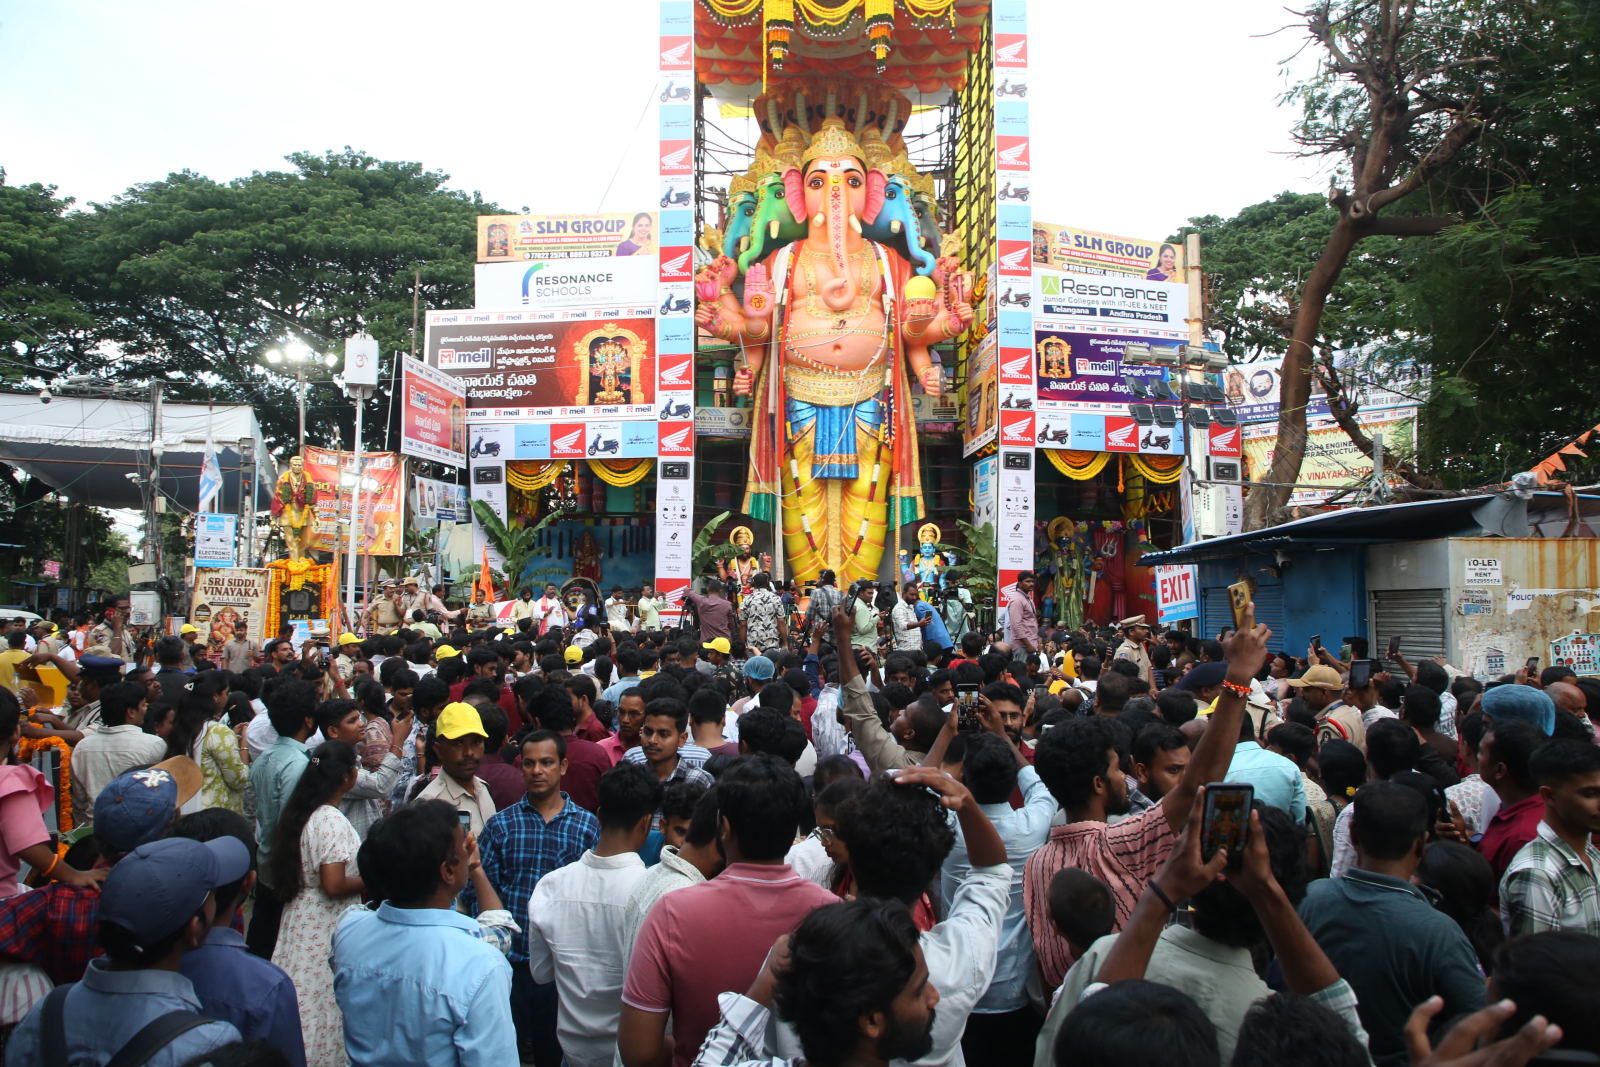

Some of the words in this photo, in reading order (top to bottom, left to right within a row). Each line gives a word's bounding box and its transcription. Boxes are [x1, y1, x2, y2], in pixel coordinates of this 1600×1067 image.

[537, 220, 568, 234] SLN
[571, 219, 626, 235] GROUP
[1074, 234, 1102, 251] SLN
[1105, 240, 1153, 259] GROUP
[536, 273, 613, 286] RESONANCE
[536, 286, 591, 298] SCHOOLS
[1061, 278, 1168, 302] Resonance
[1068, 296, 1099, 306] Colleges
[1101, 297, 1115, 306] with
[1118, 300, 1140, 309] IIT-JEE
[1052, 305, 1089, 315] Telangana
[1109, 309, 1134, 319] Andhra
[1136, 311, 1163, 321] Pradesh
[458, 349, 490, 363] meil
[1090, 360, 1114, 372] meil
[508, 374, 537, 386] చవితి
[1049, 380, 1086, 391] వినాయక
[1088, 381, 1110, 392] చవితి
[1307, 469, 1350, 481] VINAYAKA
[208, 577, 225, 586] SRI
[227, 578, 255, 588] SIDDI
[1161, 572, 1190, 604] EXIT
[203, 586, 259, 598] VINAYAKA
